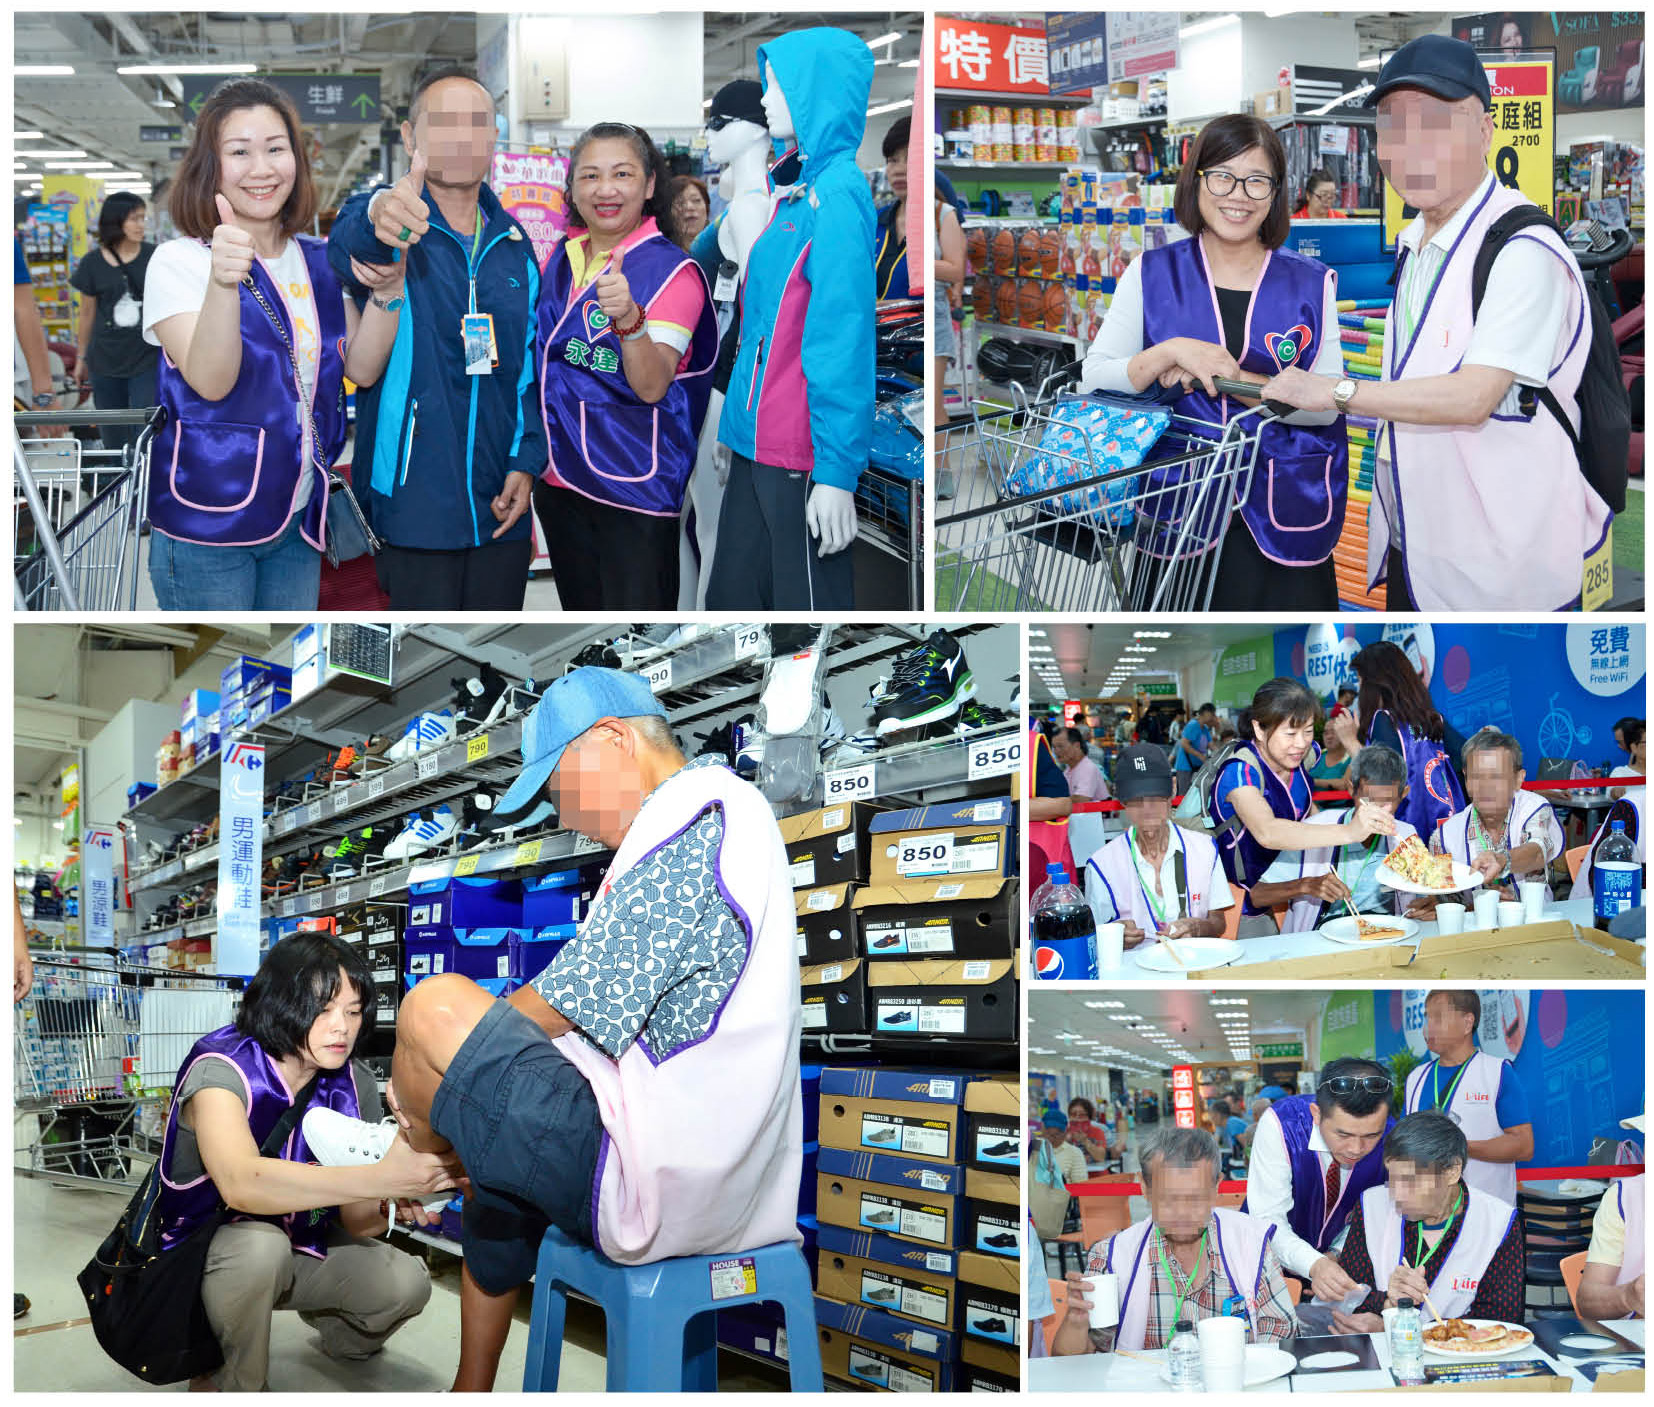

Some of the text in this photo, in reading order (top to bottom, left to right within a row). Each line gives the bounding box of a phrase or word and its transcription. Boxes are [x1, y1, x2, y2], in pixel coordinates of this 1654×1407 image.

[939, 27, 1049, 85] 特價
[308, 84, 344, 104] 生鮮
[1512, 135, 1540, 146] 2700
[564, 337, 619, 373] 永達
[1586, 558, 1609, 594] 285
[1590, 625, 1630, 655] 免費
[1308, 655, 1334, 677] REST
[650, 669, 669, 684] 90
[1590, 671, 1629, 684] Free WiFi
[974, 745, 1021, 767] 850
[829, 776, 870, 793] 850
[579, 838, 599, 849] 79
[902, 845, 947, 862] 850
[1405, 1001, 1424, 1032] RES
[711, 1259, 740, 1271] HOUSE
